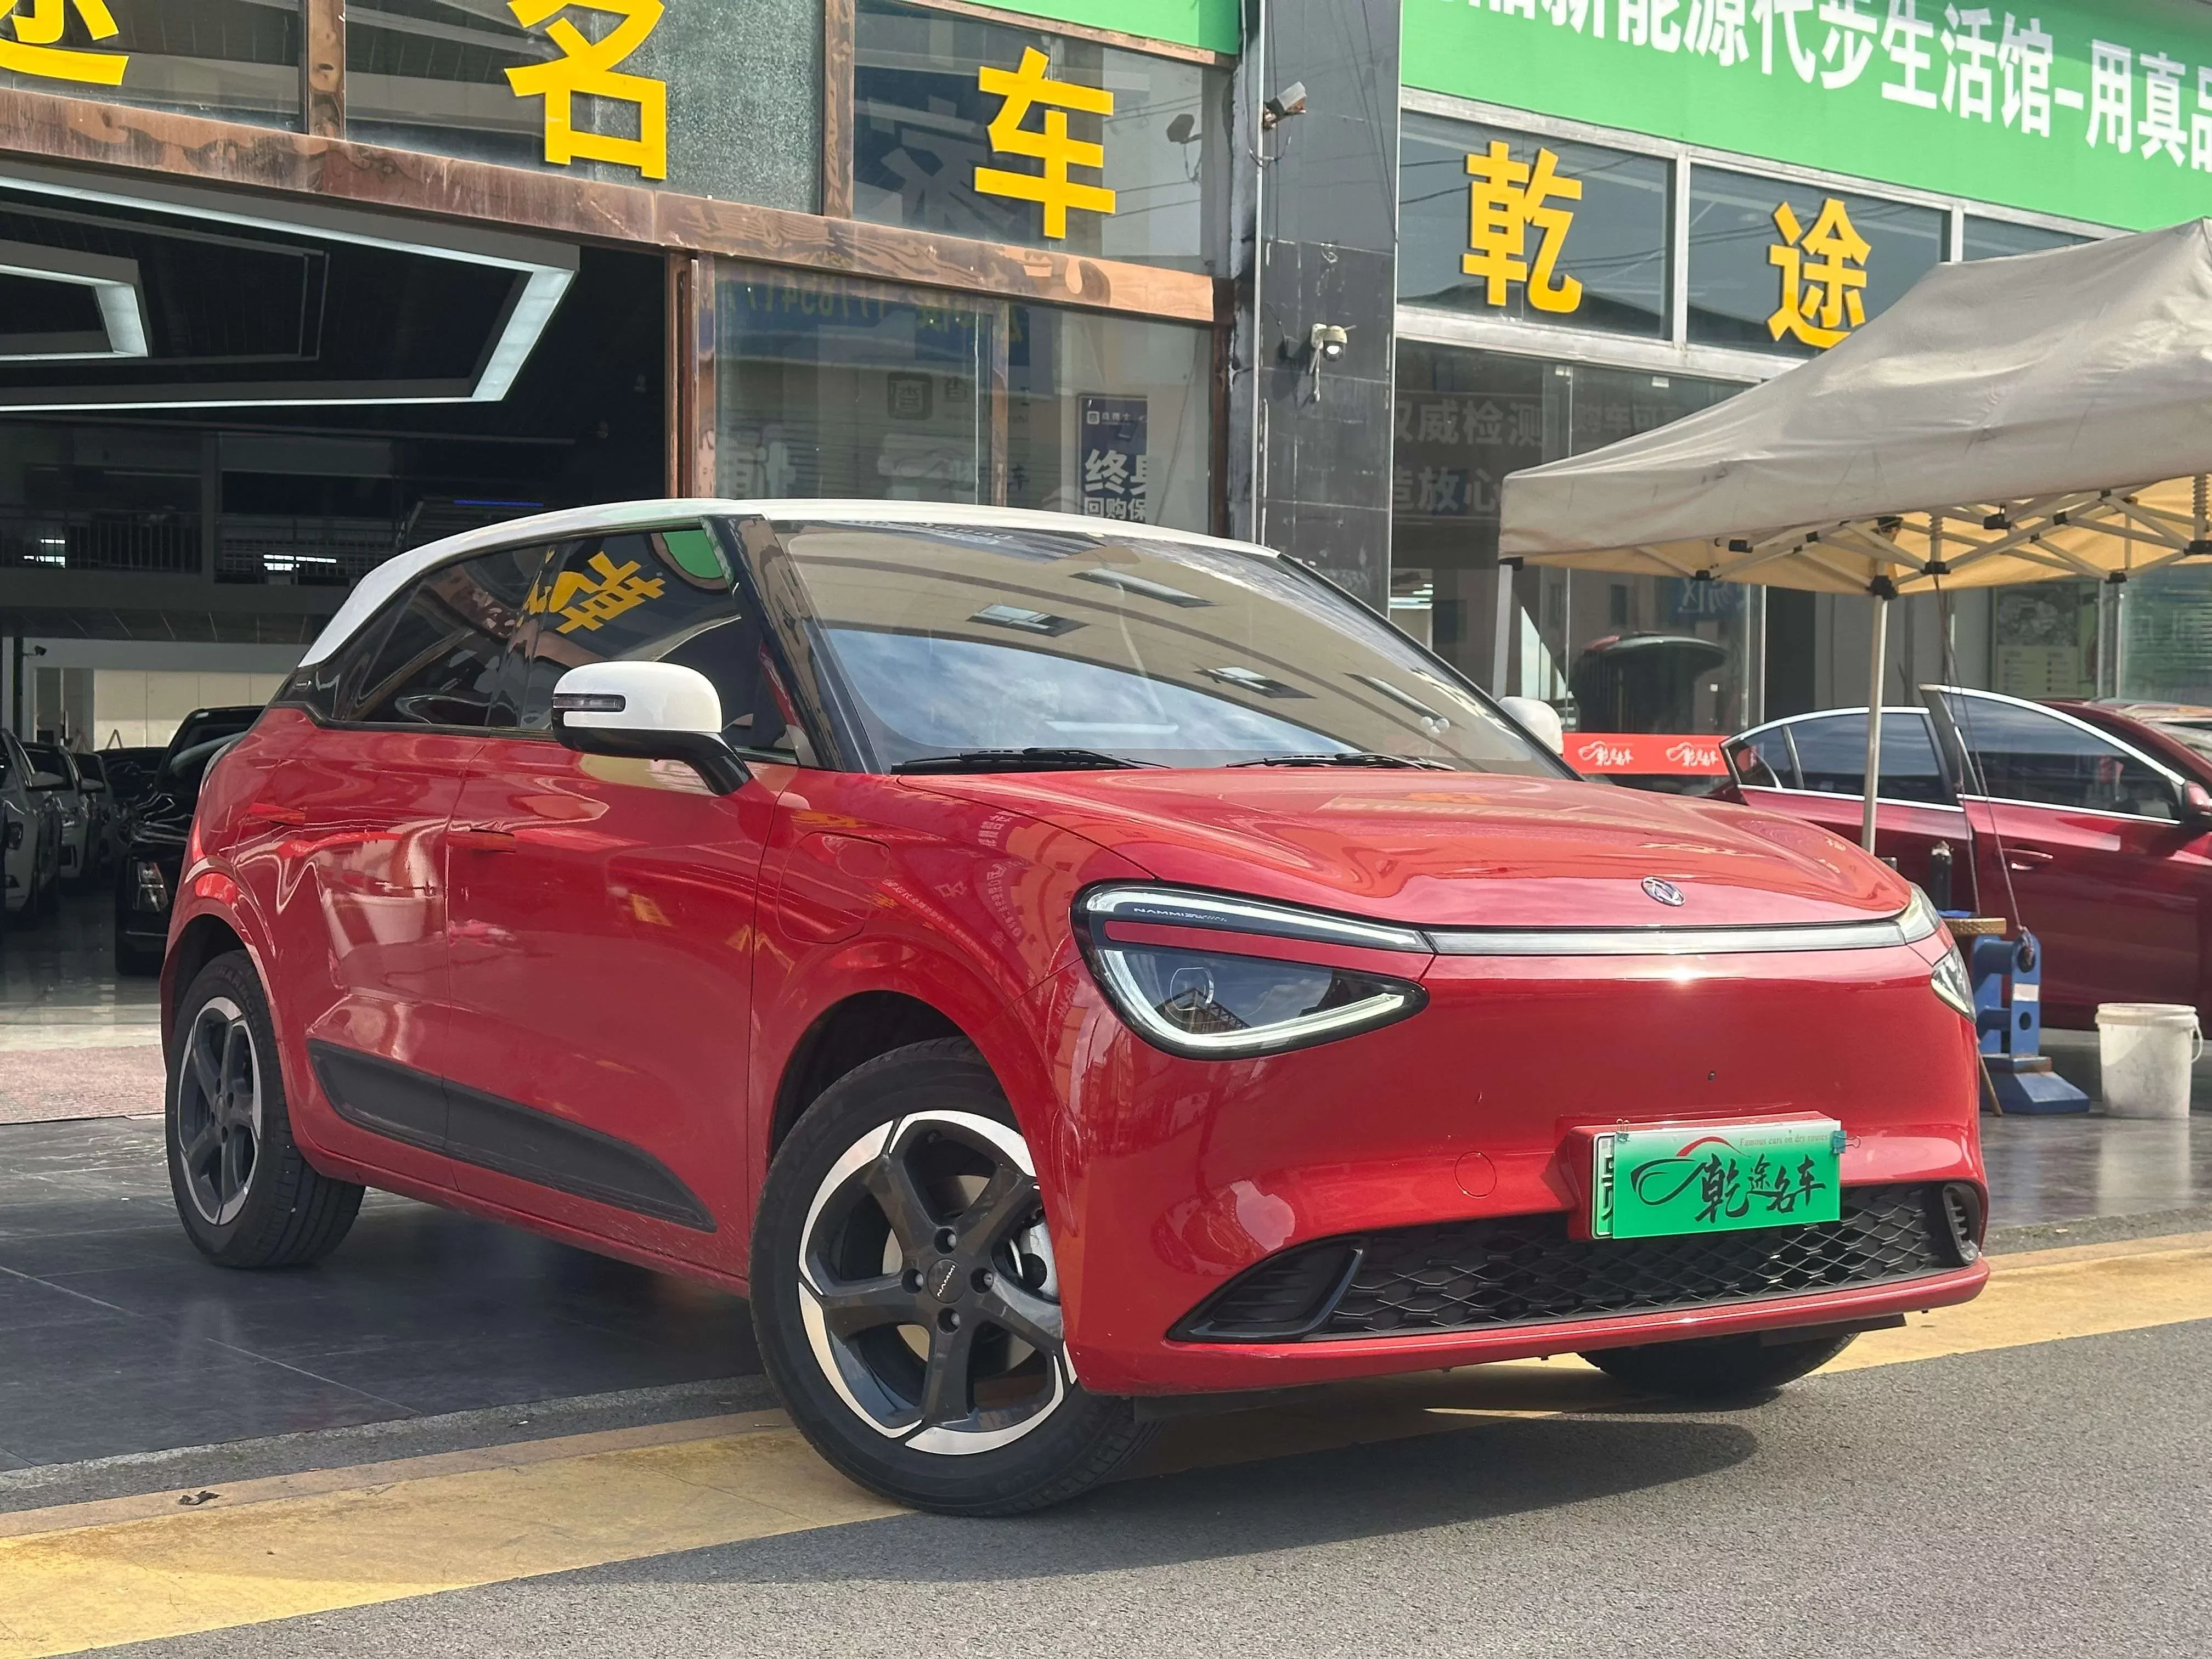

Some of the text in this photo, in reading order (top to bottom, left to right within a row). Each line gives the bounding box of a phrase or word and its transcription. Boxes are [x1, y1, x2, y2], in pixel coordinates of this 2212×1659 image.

[504, 0, 1115, 239] 名 车
[1462, 141, 1871, 348] 乾 途
[1740, 1138, 1767, 1147] Famous
[1795, 1134, 1806, 1143] dry
